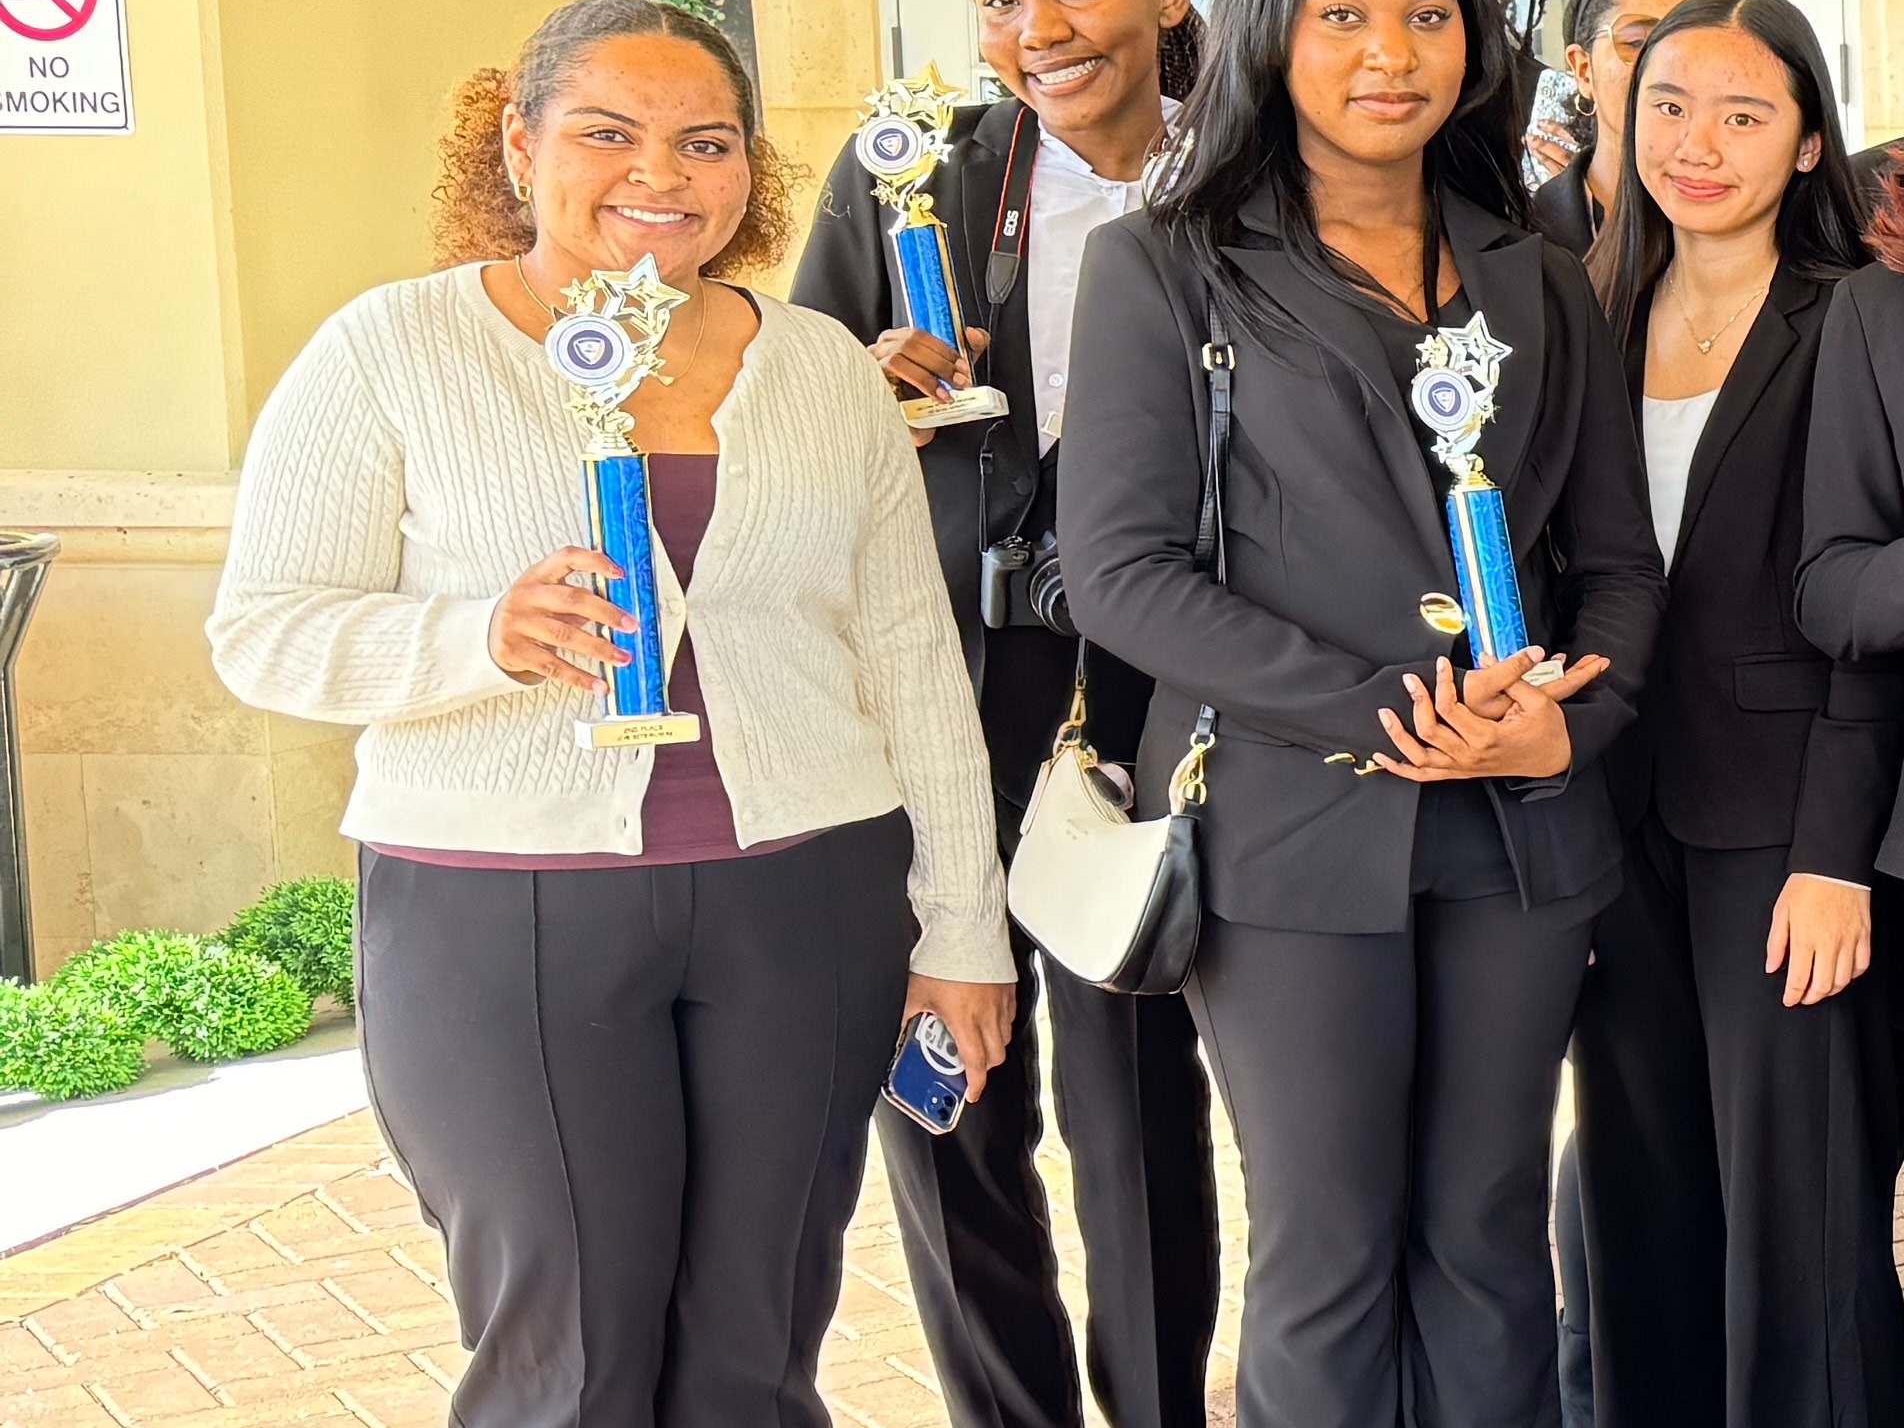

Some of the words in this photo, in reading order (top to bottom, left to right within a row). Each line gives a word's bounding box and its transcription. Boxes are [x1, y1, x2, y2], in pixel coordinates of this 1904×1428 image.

[29, 56, 70, 78] NO
[0, 90, 121, 113] MOKING
[1003, 210, 1018, 236] EOS
